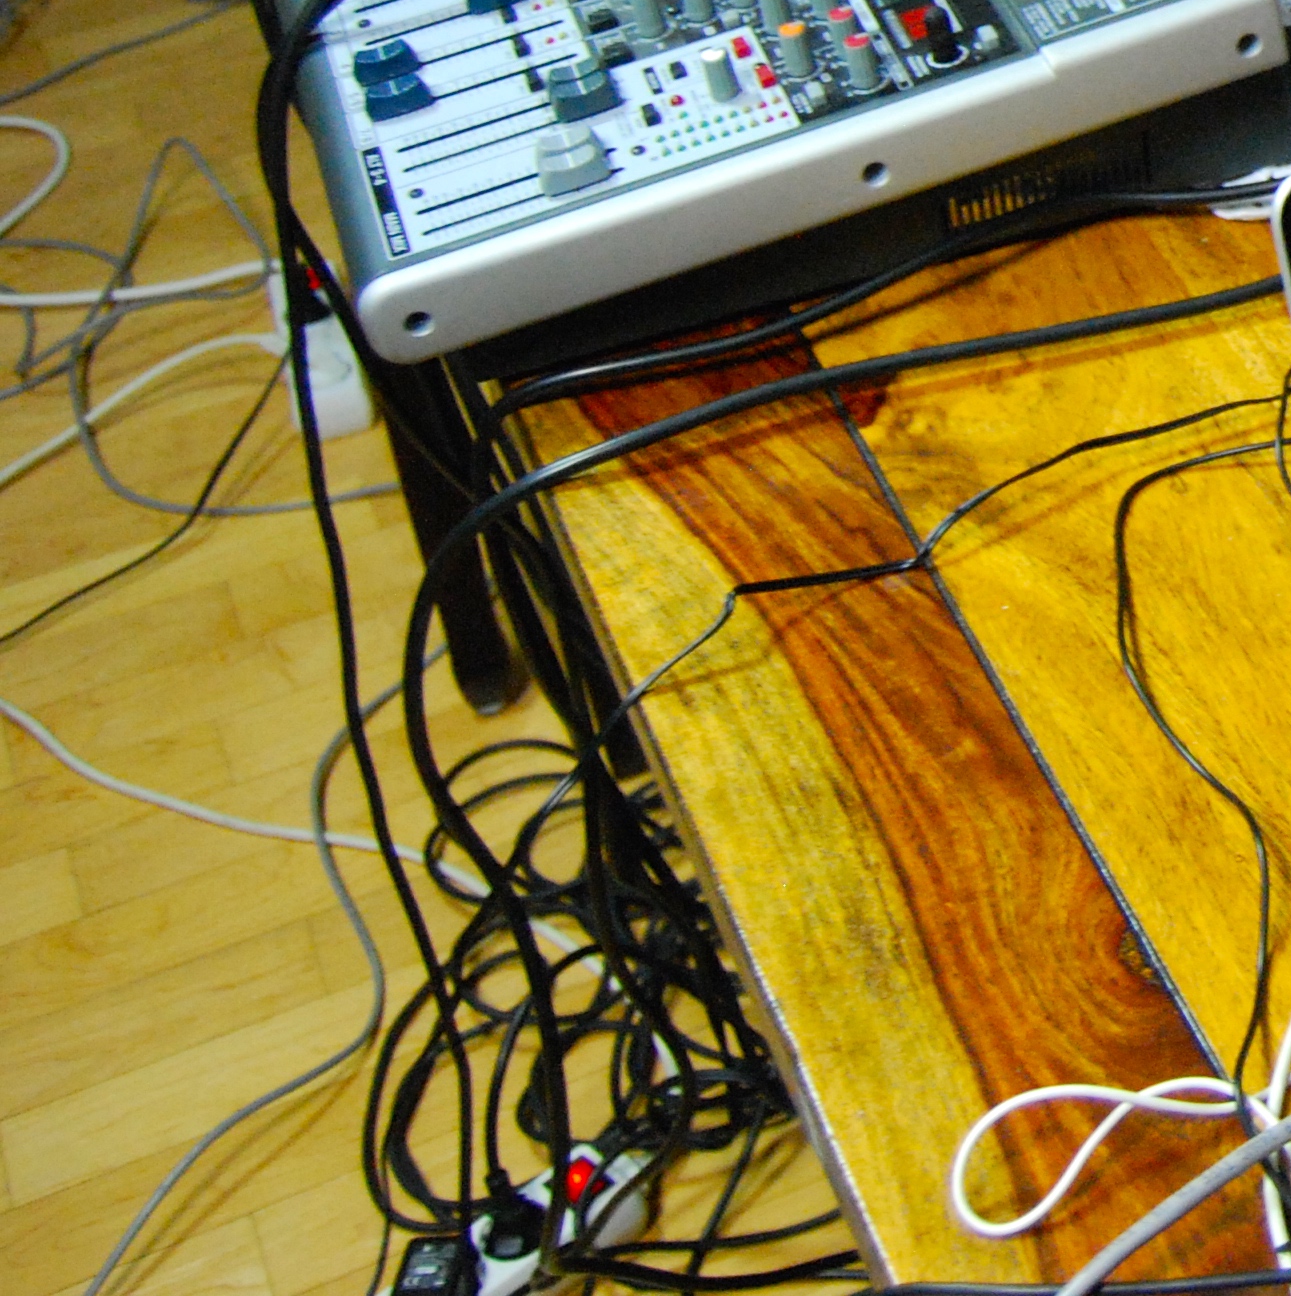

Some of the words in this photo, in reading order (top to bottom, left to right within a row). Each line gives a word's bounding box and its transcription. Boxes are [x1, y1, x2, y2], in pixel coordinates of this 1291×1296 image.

[364, 153, 383, 170] ALT
[368, 167, 387, 186] 3-4
[381, 211, 401, 237] MAIN
[388, 234, 410, 254] MIX
